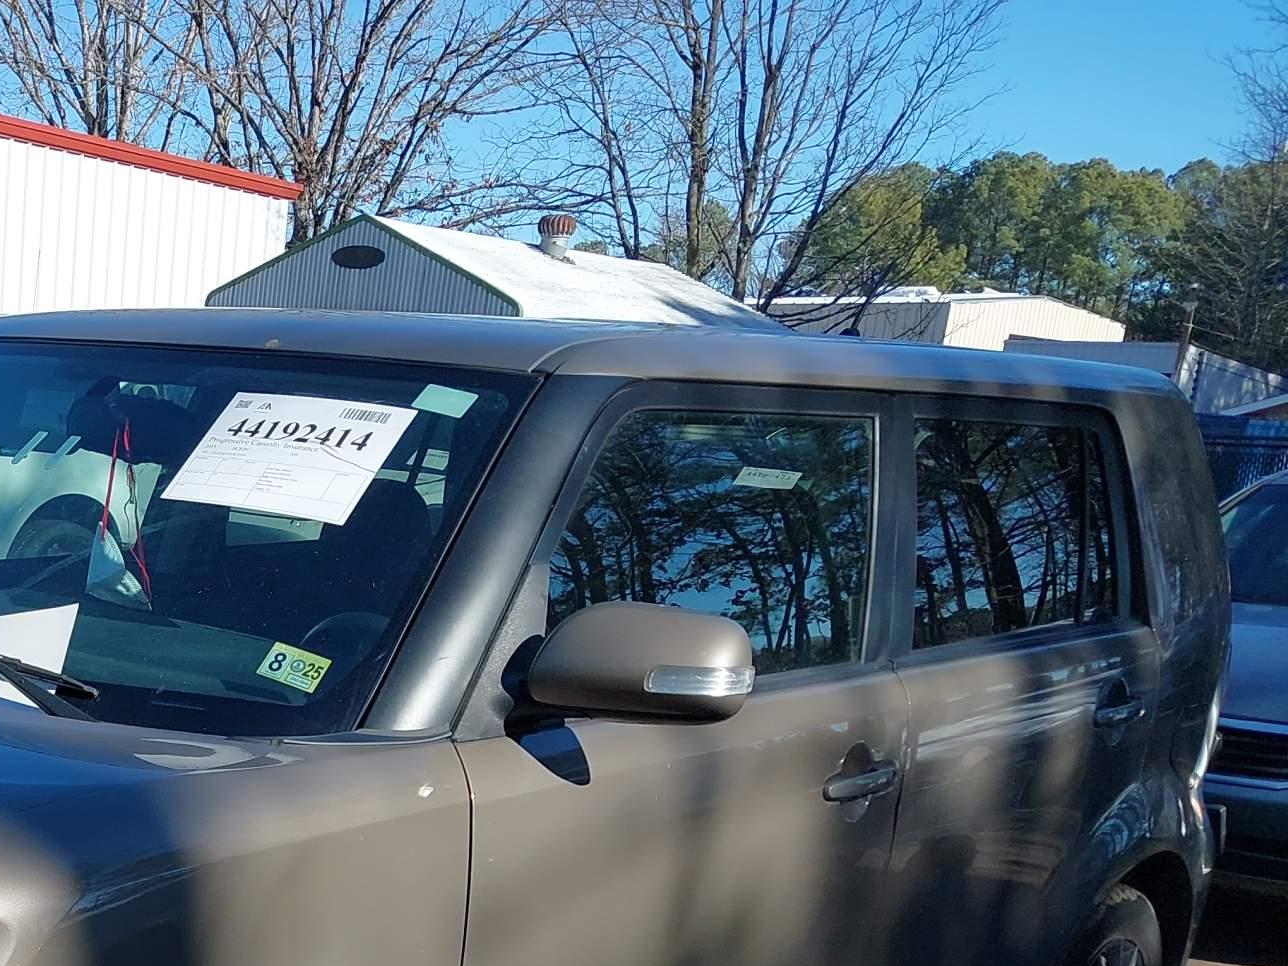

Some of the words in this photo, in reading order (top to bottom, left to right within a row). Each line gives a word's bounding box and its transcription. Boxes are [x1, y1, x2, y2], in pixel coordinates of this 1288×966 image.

[208, 436, 250, 447] Progressive
[227, 417, 373, 451] 44192414
[268, 652, 287, 672] 8
[302, 662, 325, 681] 25
